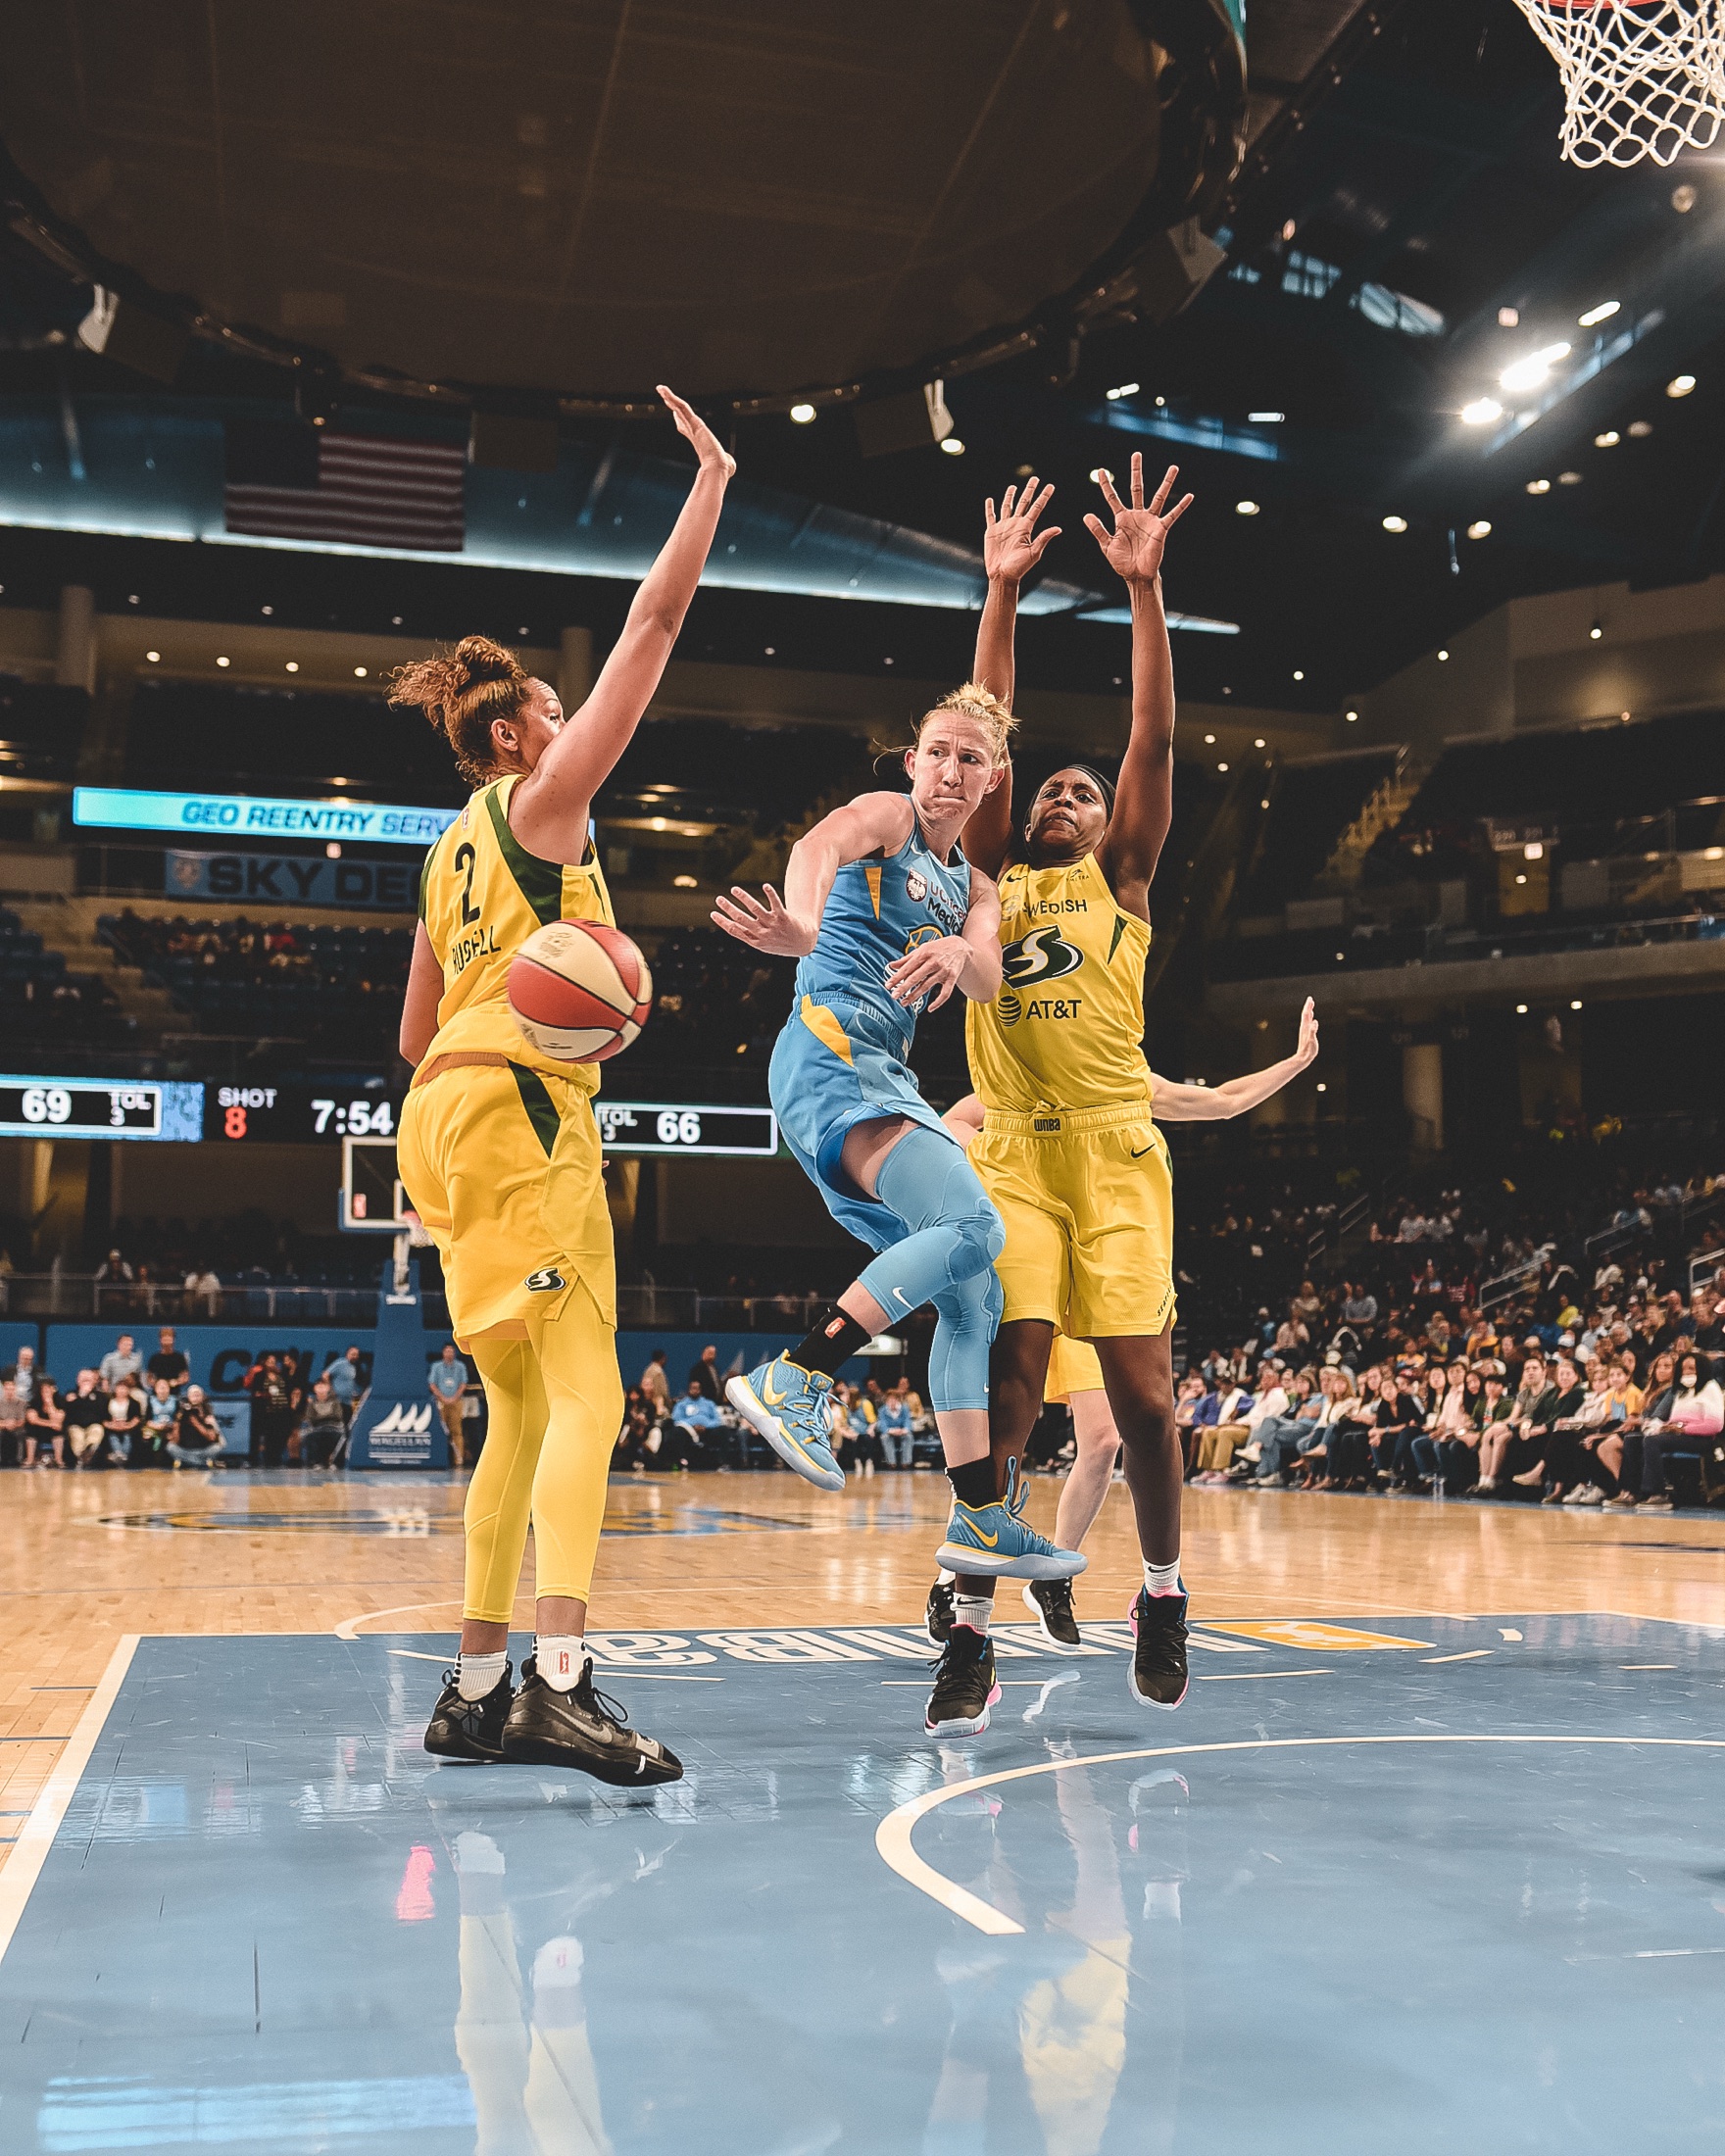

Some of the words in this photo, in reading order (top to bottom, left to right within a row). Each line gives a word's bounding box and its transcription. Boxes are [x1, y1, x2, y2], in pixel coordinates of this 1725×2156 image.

[182, 801, 239, 826] GEO
[246, 806, 374, 834] REENTRY
[208, 857, 330, 898] SKY
[335, 863, 422, 904] DE
[455, 842, 480, 927] 2
[1025, 999, 1082, 1020] AT&T
[22, 1089, 72, 1123] 69
[108, 1091, 152, 1109] TOL
[218, 1087, 277, 1108] SHOT
[110, 1105, 125, 1126] 3
[224, 1105, 247, 1139] 8
[311, 1099, 394, 1135] 7:54
[599, 1107, 638, 1126] TOL
[603, 1123, 616, 1141] 3
[657, 1111, 700, 1144] 66
